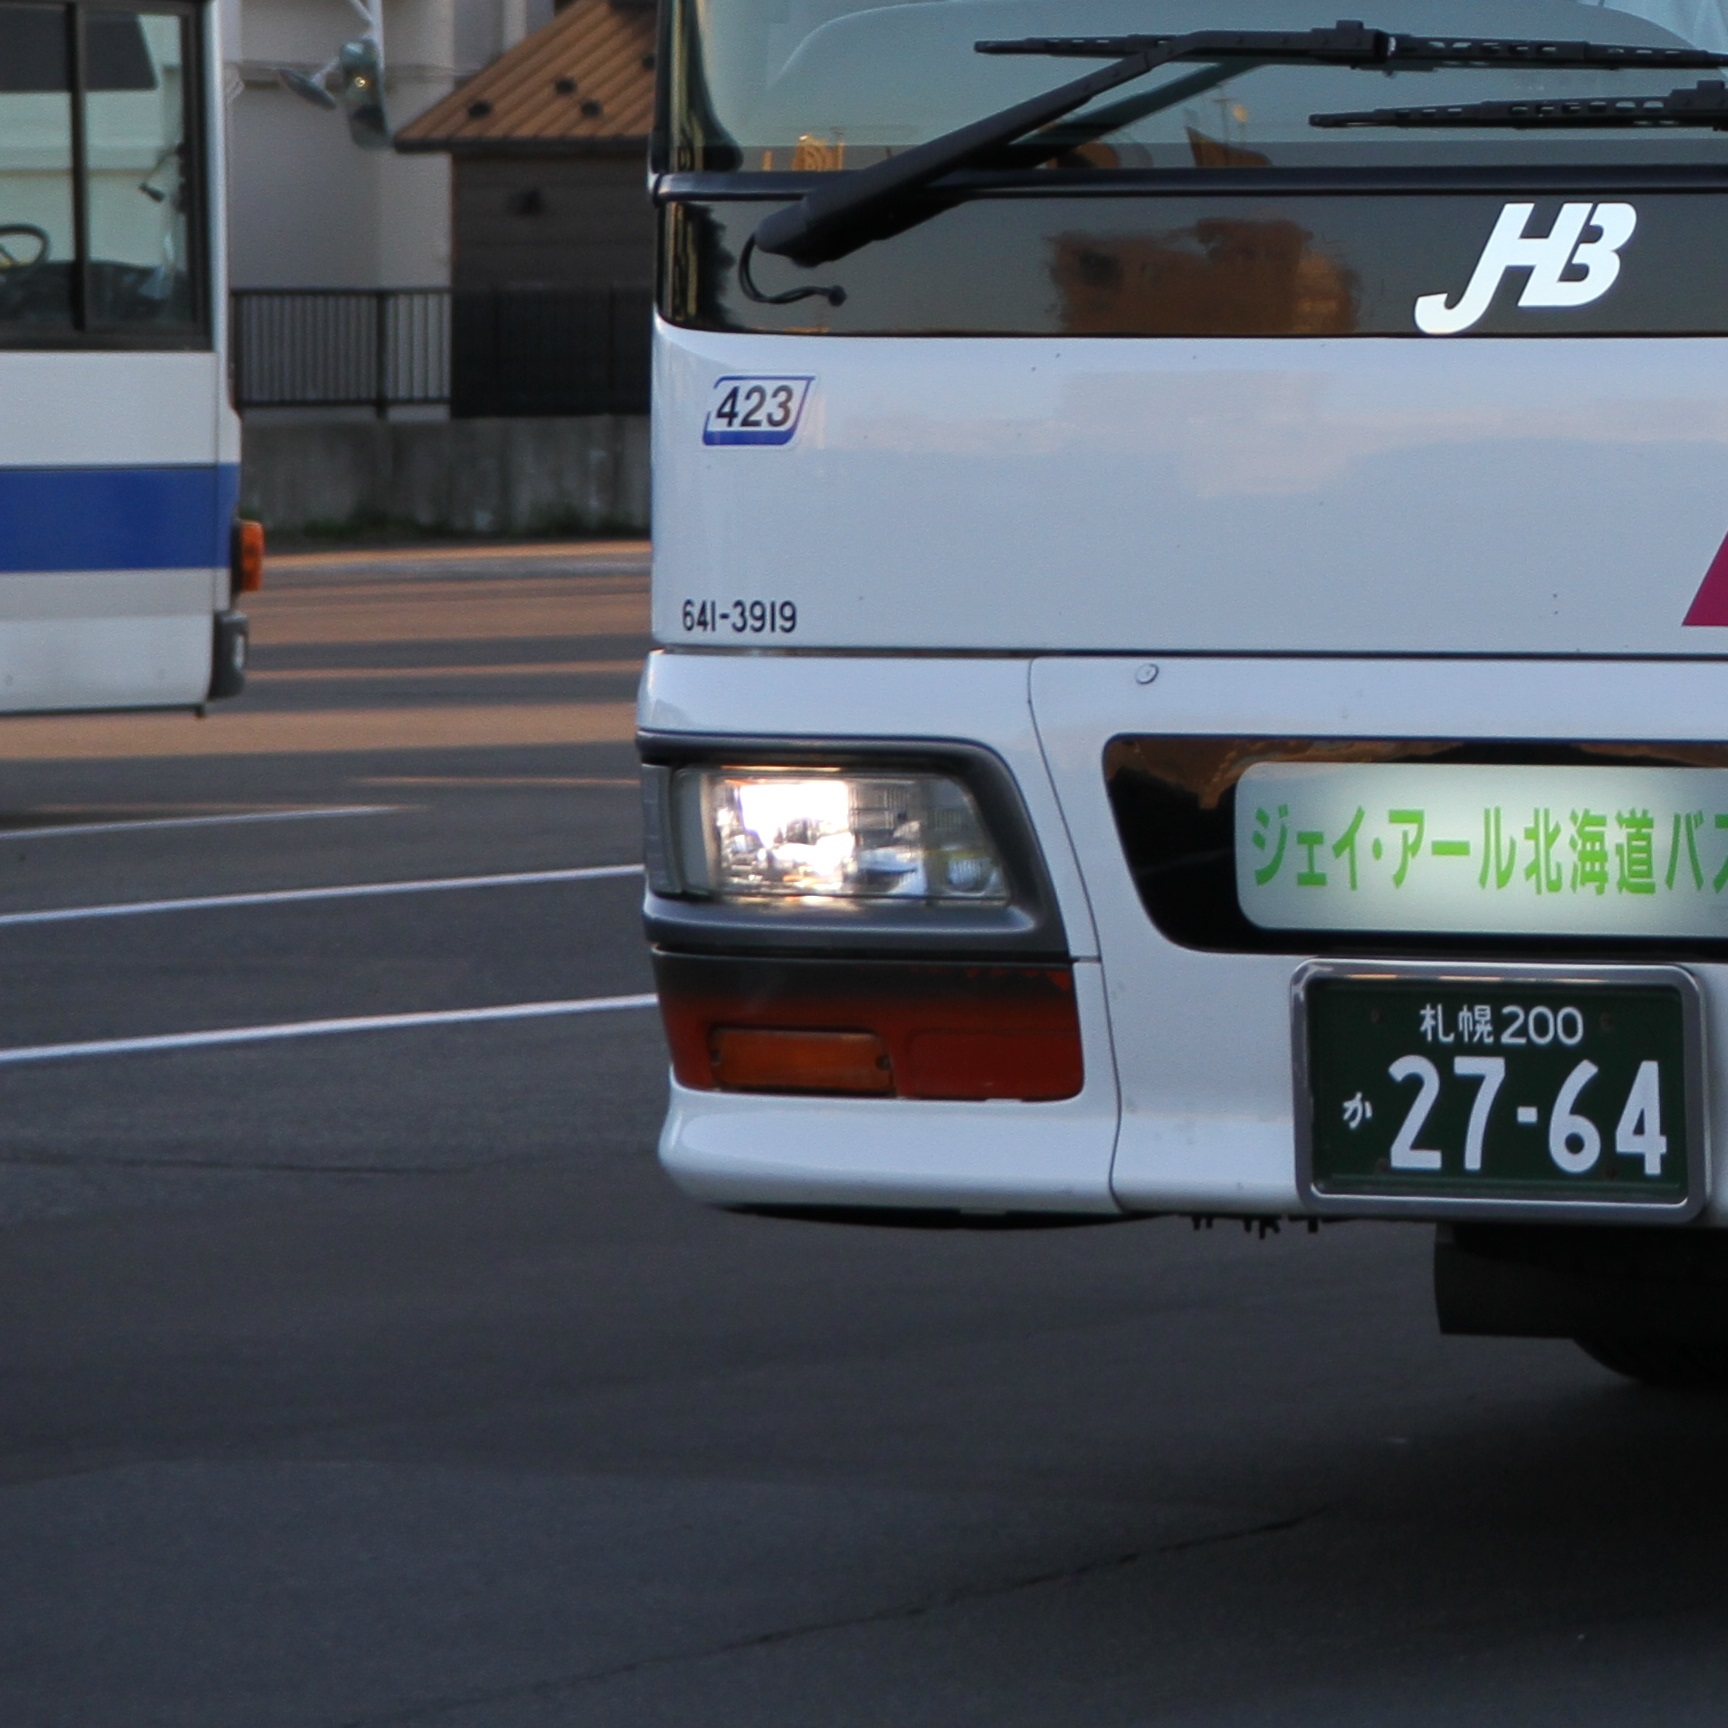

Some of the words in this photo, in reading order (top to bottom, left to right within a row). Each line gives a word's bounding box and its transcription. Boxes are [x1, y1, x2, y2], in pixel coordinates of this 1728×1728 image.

[1414, 202, 1637, 335] JHB
[716, 384, 794, 428] 423
[682, 598, 797, 633] 641-3919
[1342, 1091, 1372, 1130] か
[1388, 1054, 1667, 1176] 27-64
